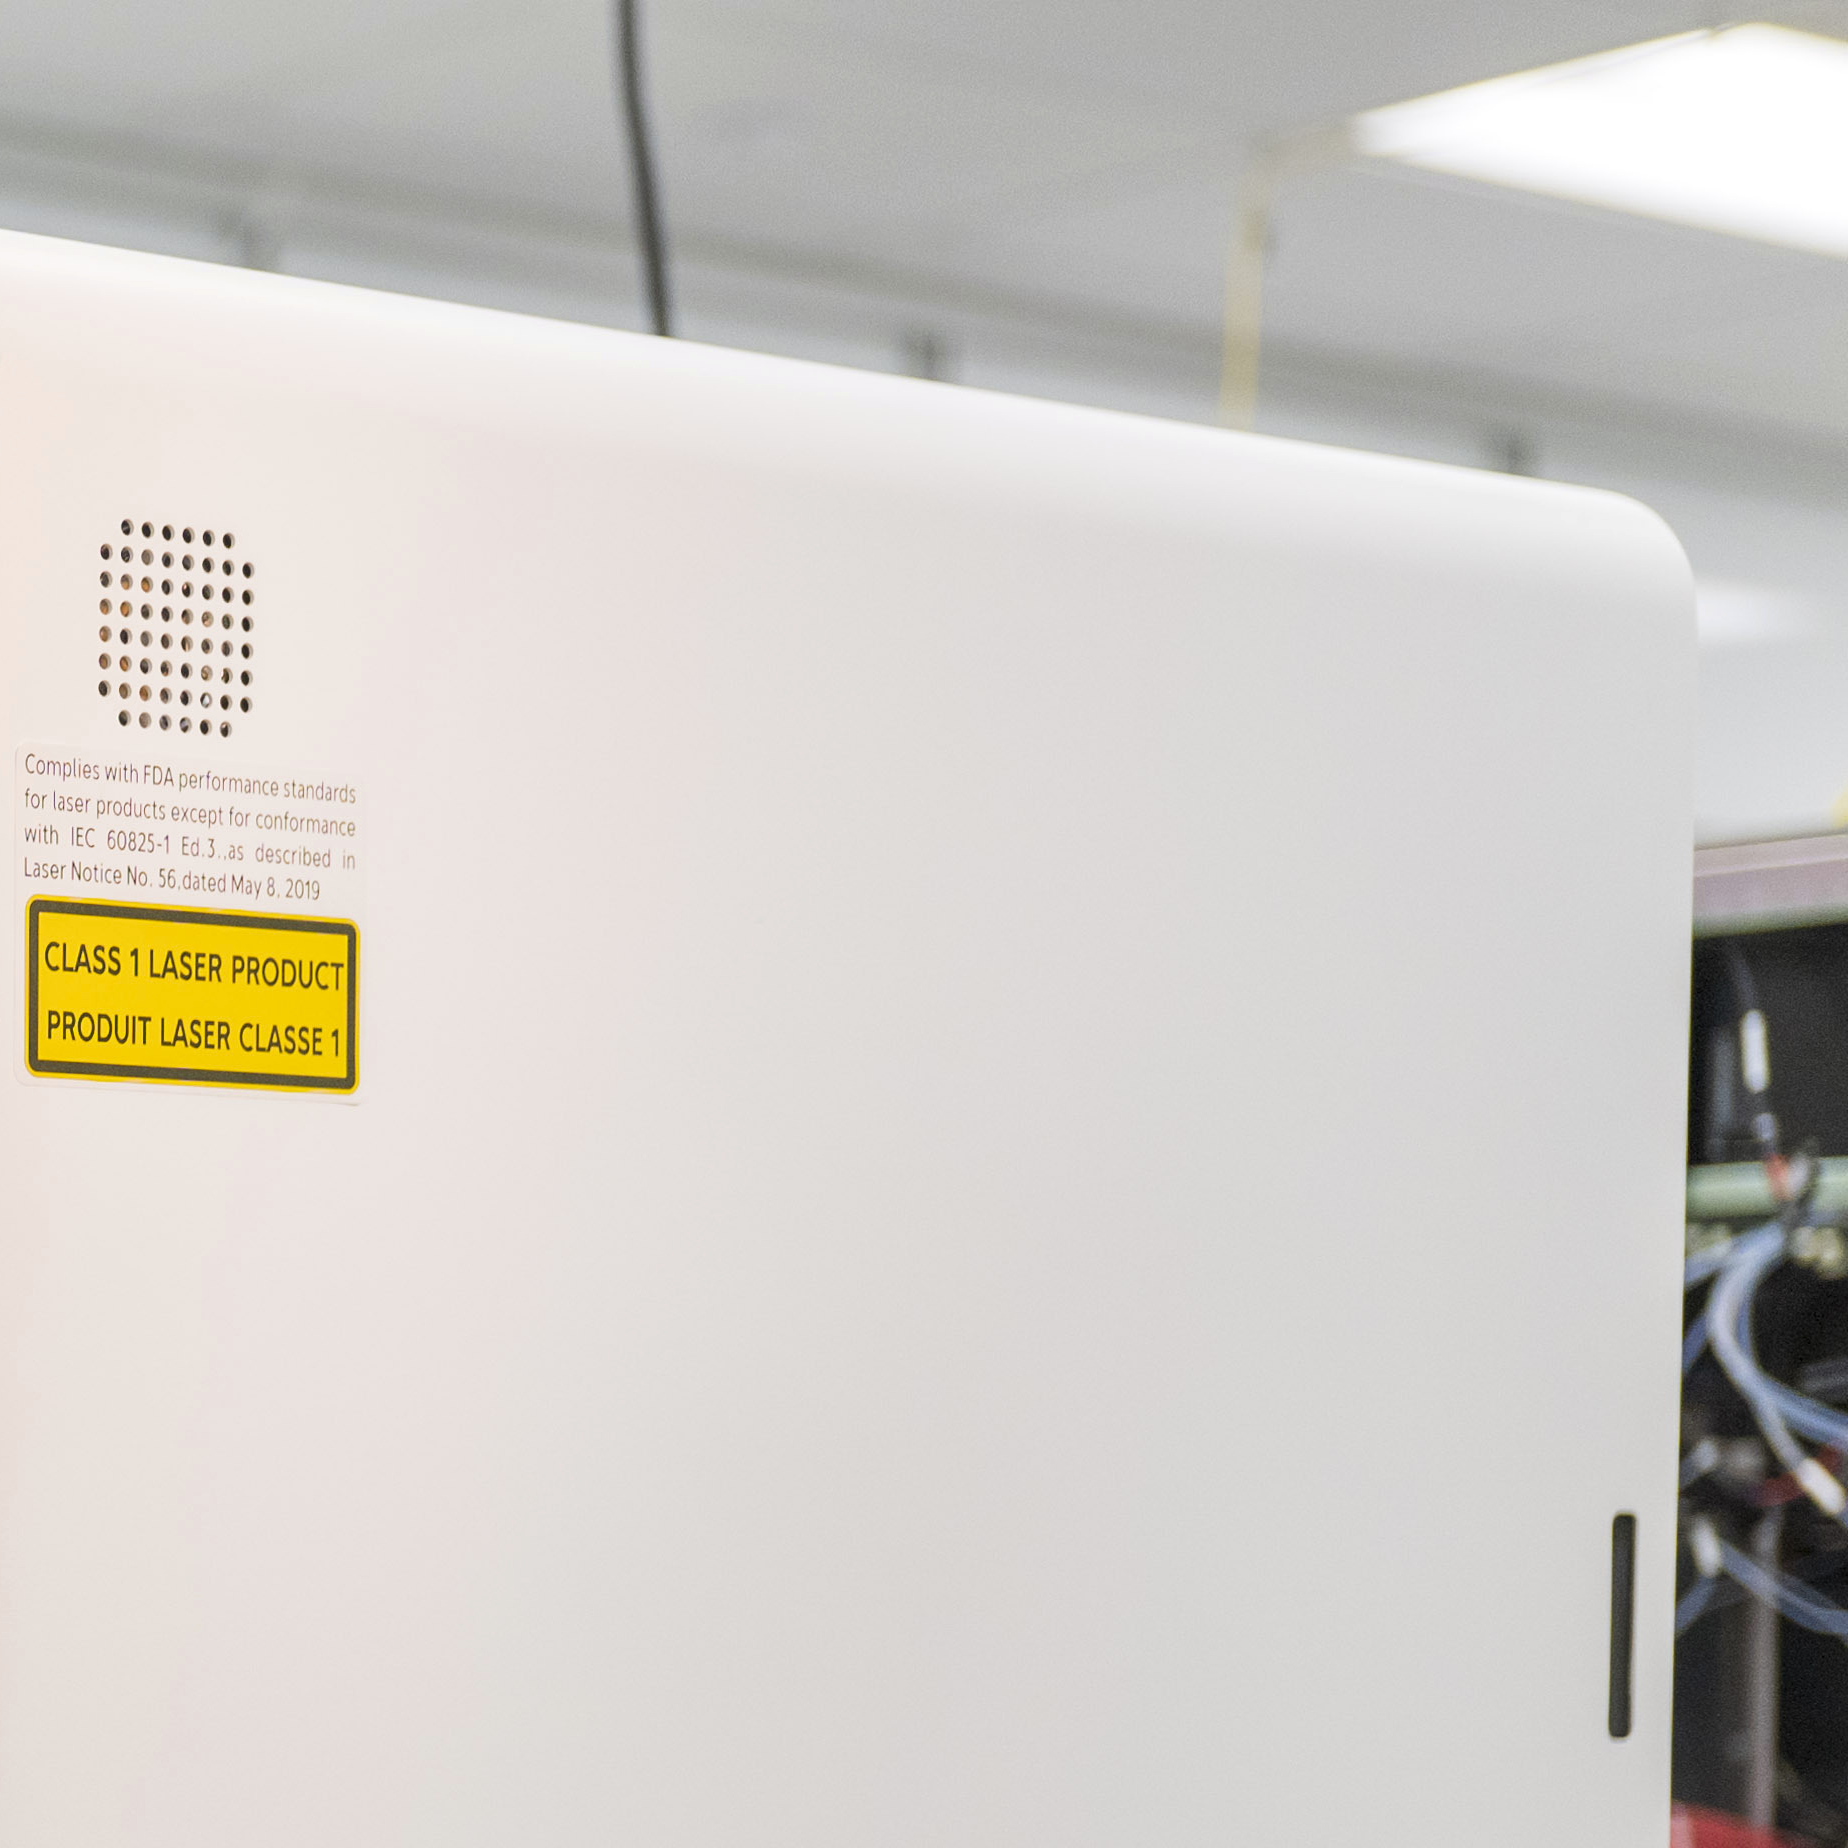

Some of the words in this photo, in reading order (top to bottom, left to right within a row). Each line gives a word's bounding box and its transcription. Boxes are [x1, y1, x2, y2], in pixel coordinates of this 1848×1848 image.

[25, 753, 100, 782] Complies
[105, 762, 139, 784] with
[143, 765, 174, 787] FDA
[179, 770, 279, 797] performance
[284, 780, 356, 804] standards
[25, 788, 47, 809] for
[53, 790, 91, 813] laser
[96, 798, 166, 820] products
[171, 805, 224, 829] except
[229, 806, 251, 828] for
[255, 811, 356, 837] conformance
[24, 824, 59, 845] with
[71, 827, 96, 848] IEC
[107, 830, 170, 854] 60825-1
[255, 844, 331, 868] described
[343, 850, 356, 870] in
[24, 857, 66, 879] Laser
[71, 861, 122, 885] Notice
[127, 865, 153, 887] No.
[231, 874, 262, 900] May
[285, 878, 320, 901] 2019
[44, 941, 121, 976] CLASS
[130, 948, 139, 977] 1
[149, 949, 222, 983] LASER
[232, 955, 344, 990] PRODUCT
[47, 1010, 152, 1045] PRODUIT
[160, 1018, 231, 1050] LASER
[239, 1023, 323, 1056] CLASSE
[331, 1029, 340, 1057] 1
